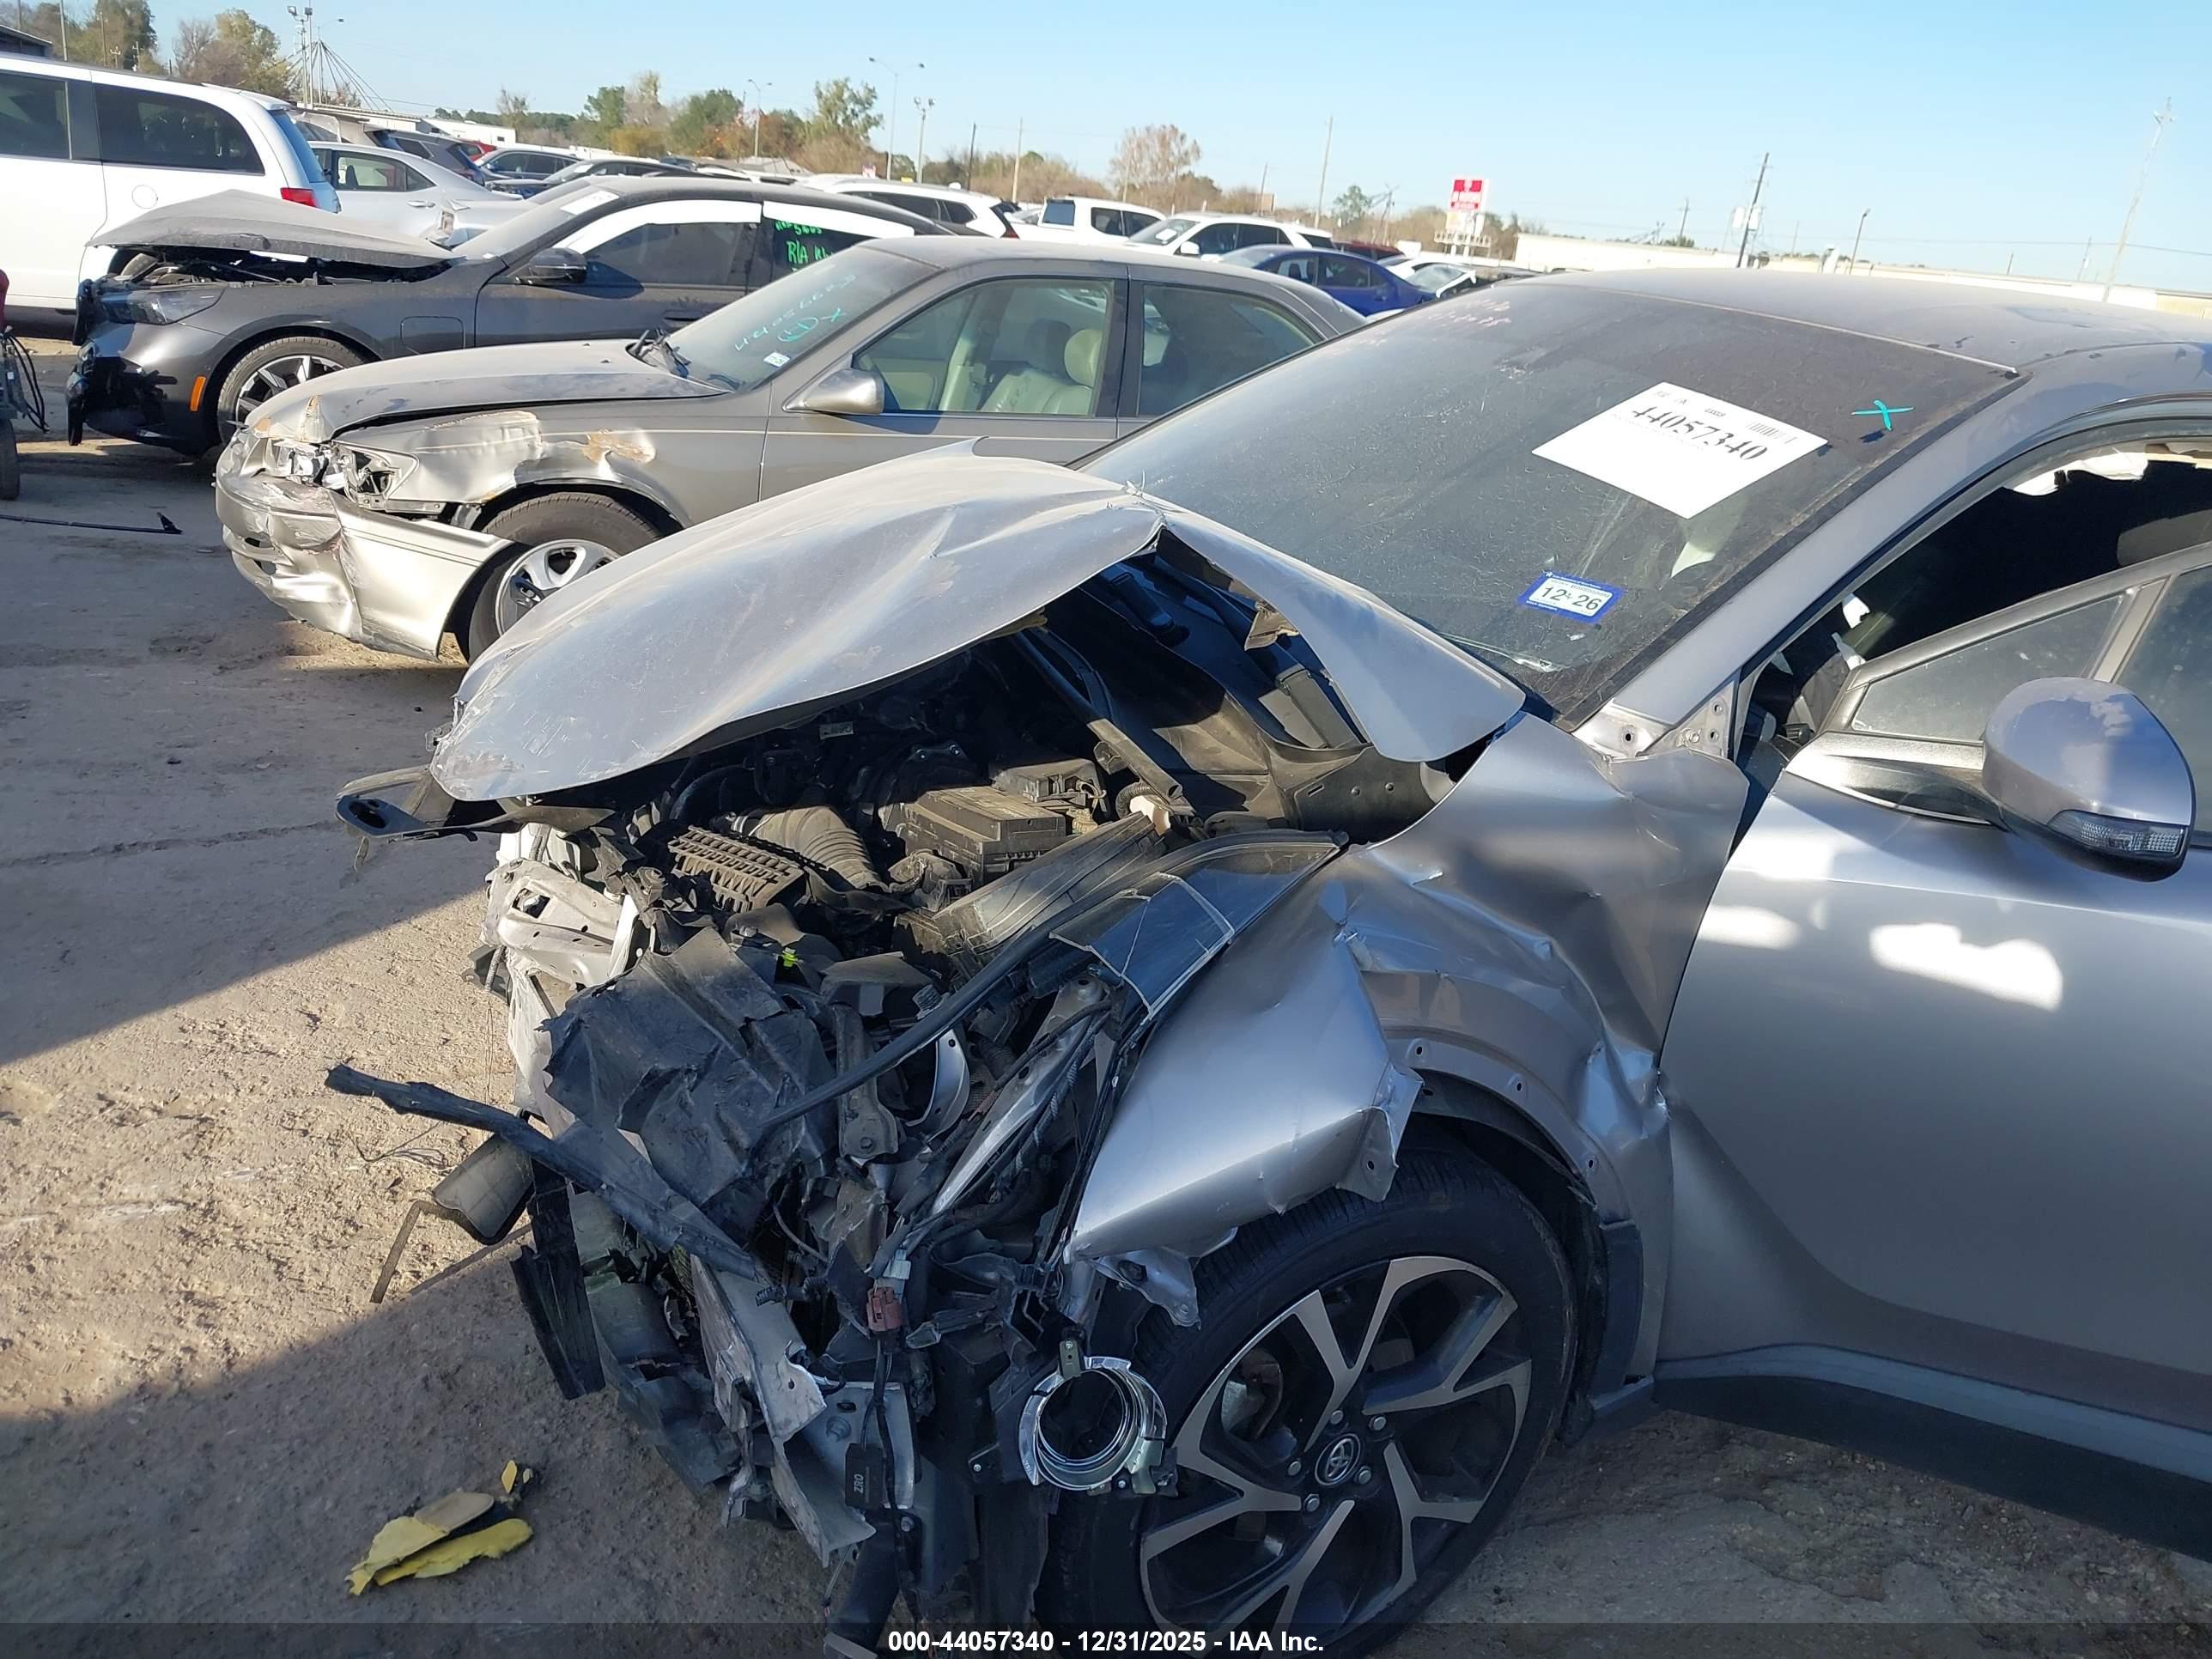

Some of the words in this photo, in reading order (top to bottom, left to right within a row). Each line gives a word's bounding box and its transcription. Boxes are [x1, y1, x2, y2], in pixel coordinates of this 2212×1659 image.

[1632, 405, 1768, 460] 44057340
[1542, 586, 1567, 601] 12
[1571, 594, 1602, 611] 26
